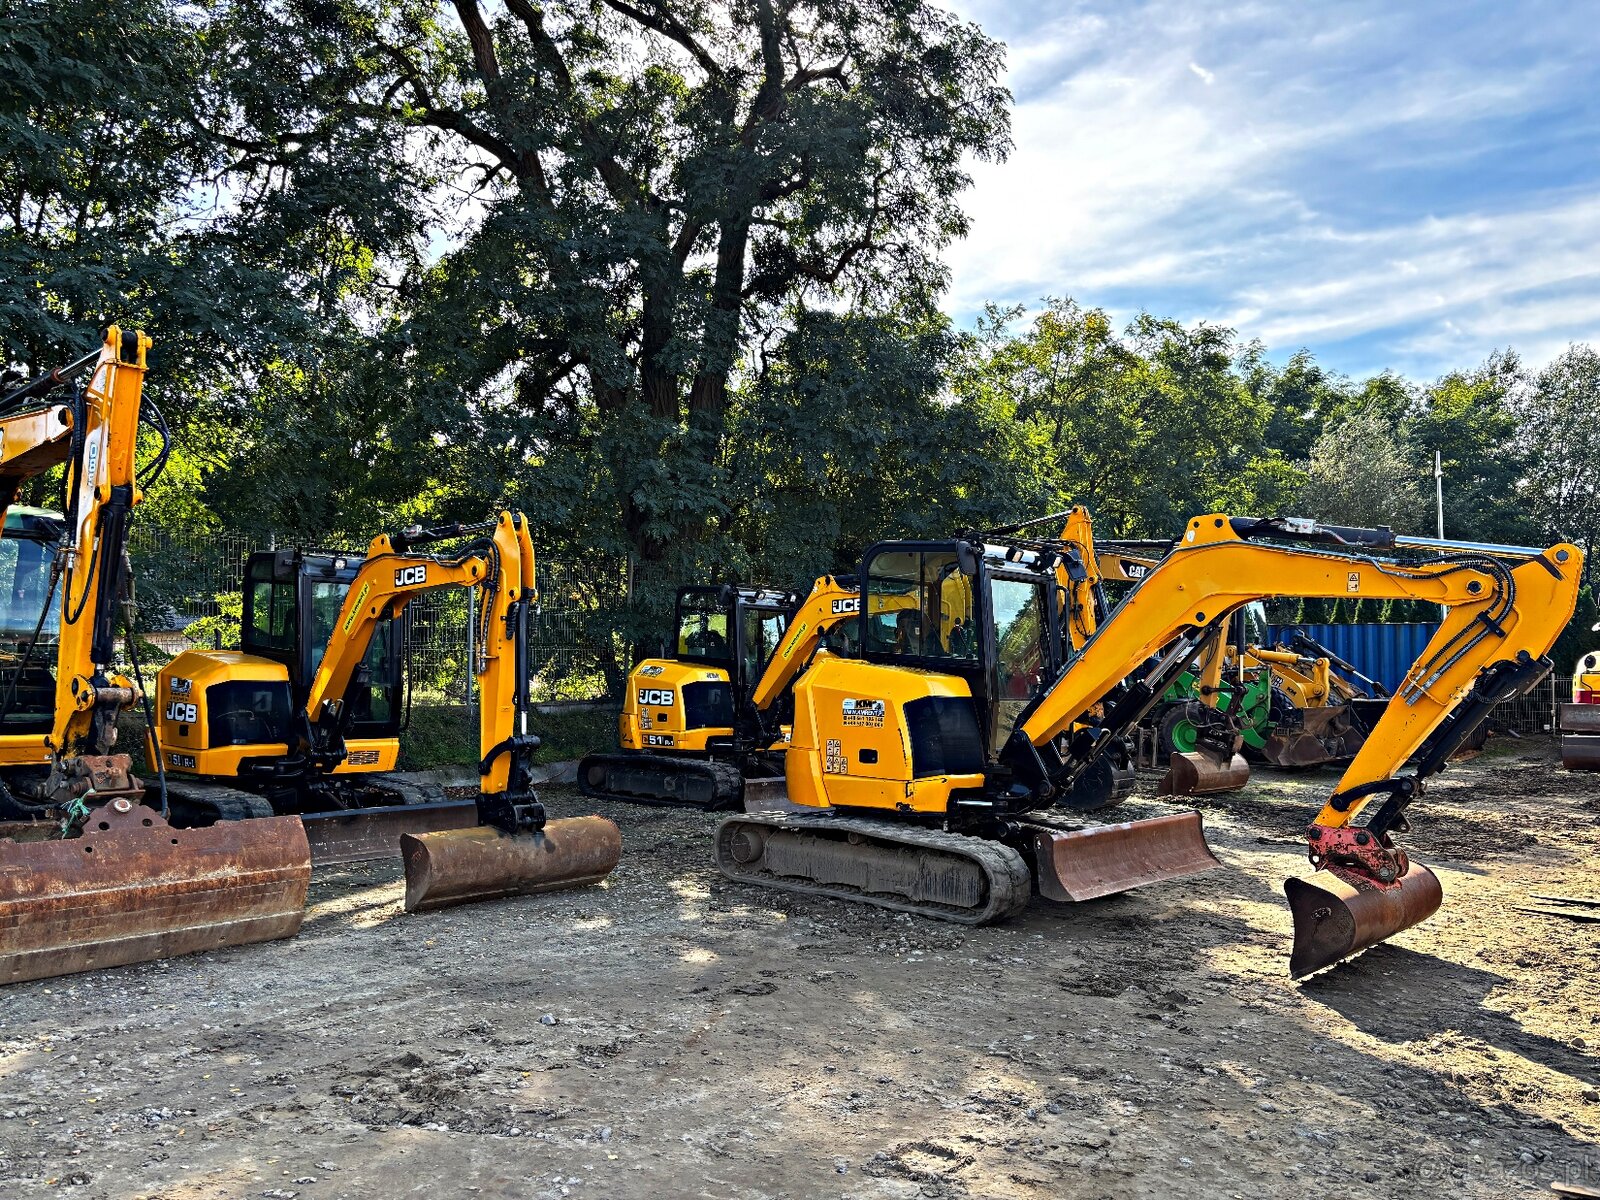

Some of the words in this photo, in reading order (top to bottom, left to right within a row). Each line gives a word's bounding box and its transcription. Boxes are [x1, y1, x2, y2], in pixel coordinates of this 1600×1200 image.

[395, 566, 426, 586] JCB
[1128, 565, 1147, 578] CAT
[639, 690, 674, 705] JCB
[166, 702, 197, 723] JCB
